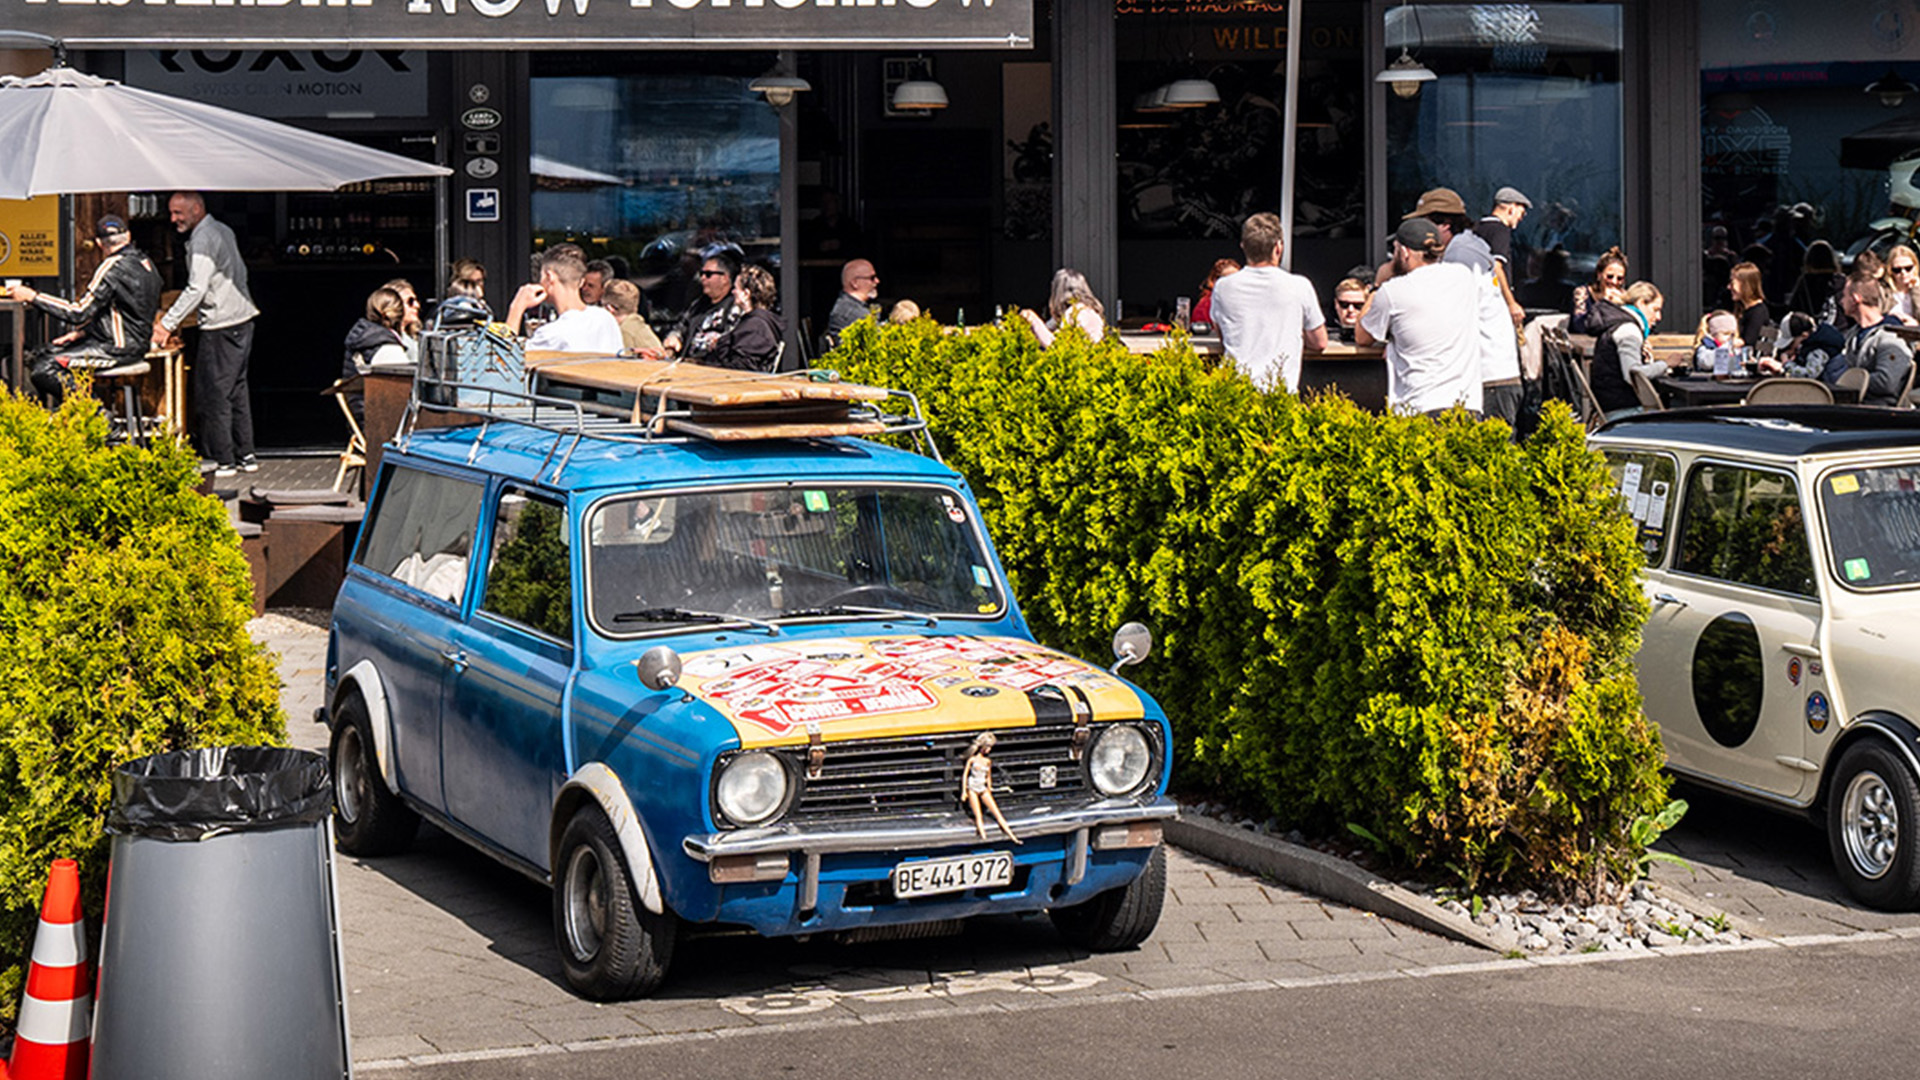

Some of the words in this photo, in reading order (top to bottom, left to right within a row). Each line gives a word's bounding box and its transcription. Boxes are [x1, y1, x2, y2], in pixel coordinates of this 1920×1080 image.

[1213, 27, 1288, 49] WILD
[297, 82, 363, 96] MOTION
[20, 240, 54, 248] ANDERE
